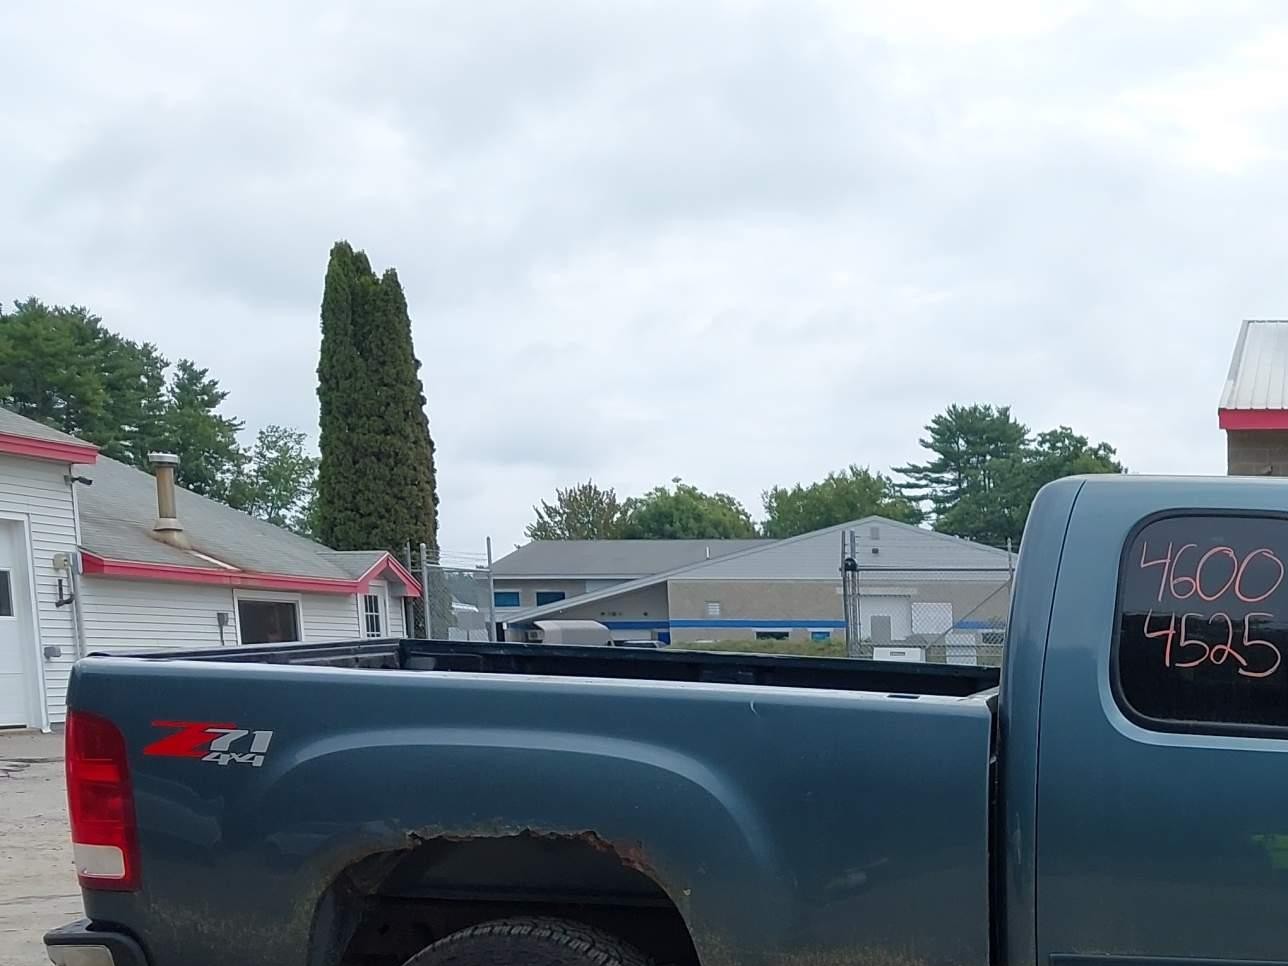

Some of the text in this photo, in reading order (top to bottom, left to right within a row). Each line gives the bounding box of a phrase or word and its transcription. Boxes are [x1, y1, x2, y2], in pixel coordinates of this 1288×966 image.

[1140, 541, 1284, 602] 4600
[1143, 608, 1281, 678] 4525
[143, 720, 274, 757] Z71
